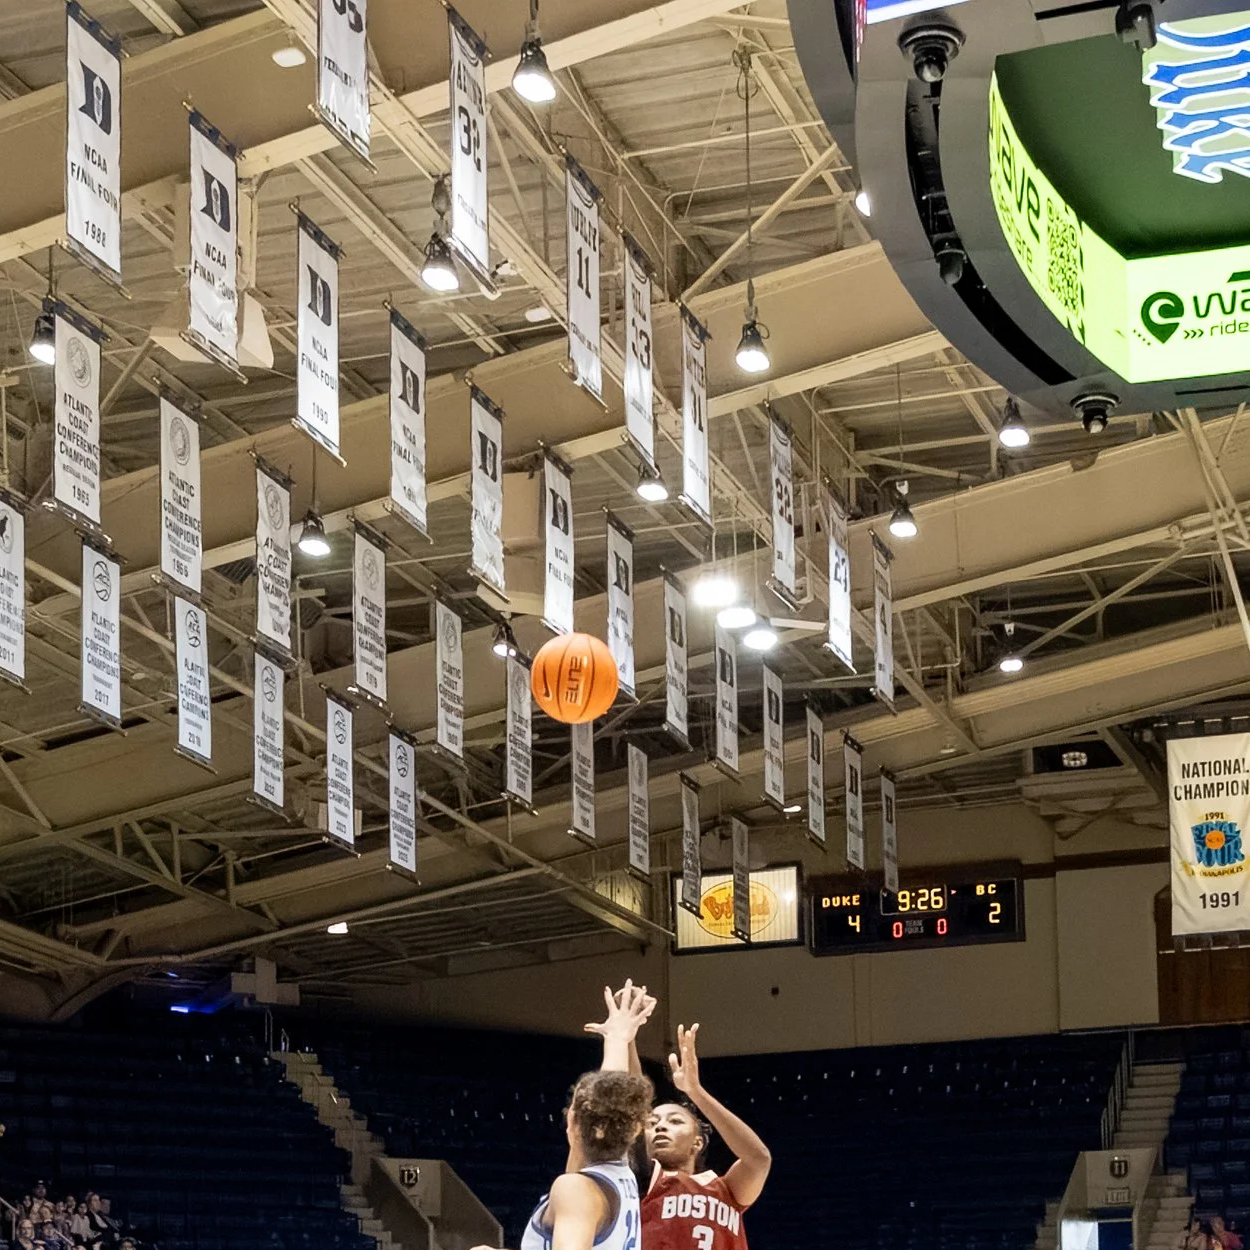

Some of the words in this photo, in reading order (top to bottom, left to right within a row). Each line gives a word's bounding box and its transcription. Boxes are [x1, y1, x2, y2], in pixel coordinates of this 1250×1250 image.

[84, 143, 108, 175] NCAA
[70, 161, 97, 194] FINAL
[205, 241, 228, 270] NCAA
[63, 392, 92, 422] ATLANTIC
[69, 412, 89, 436] COAST
[60, 441, 98, 476] CHAMPIONS
[165, 516, 199, 548] CHAMPIONS
[1205, 812, 1225, 820] 1991
[822, 894, 860, 908] DUKE
[897, 888, 944, 912] 9:26
[976, 883, 997, 896] BC
[1199, 891, 1240, 909] 1991
[848, 914, 861, 933] 4
[988, 903, 1001, 924] 2
[893, 921, 902, 938] 0
[937, 918, 947, 935] 0
[661, 1193, 741, 1237] BOSTON
